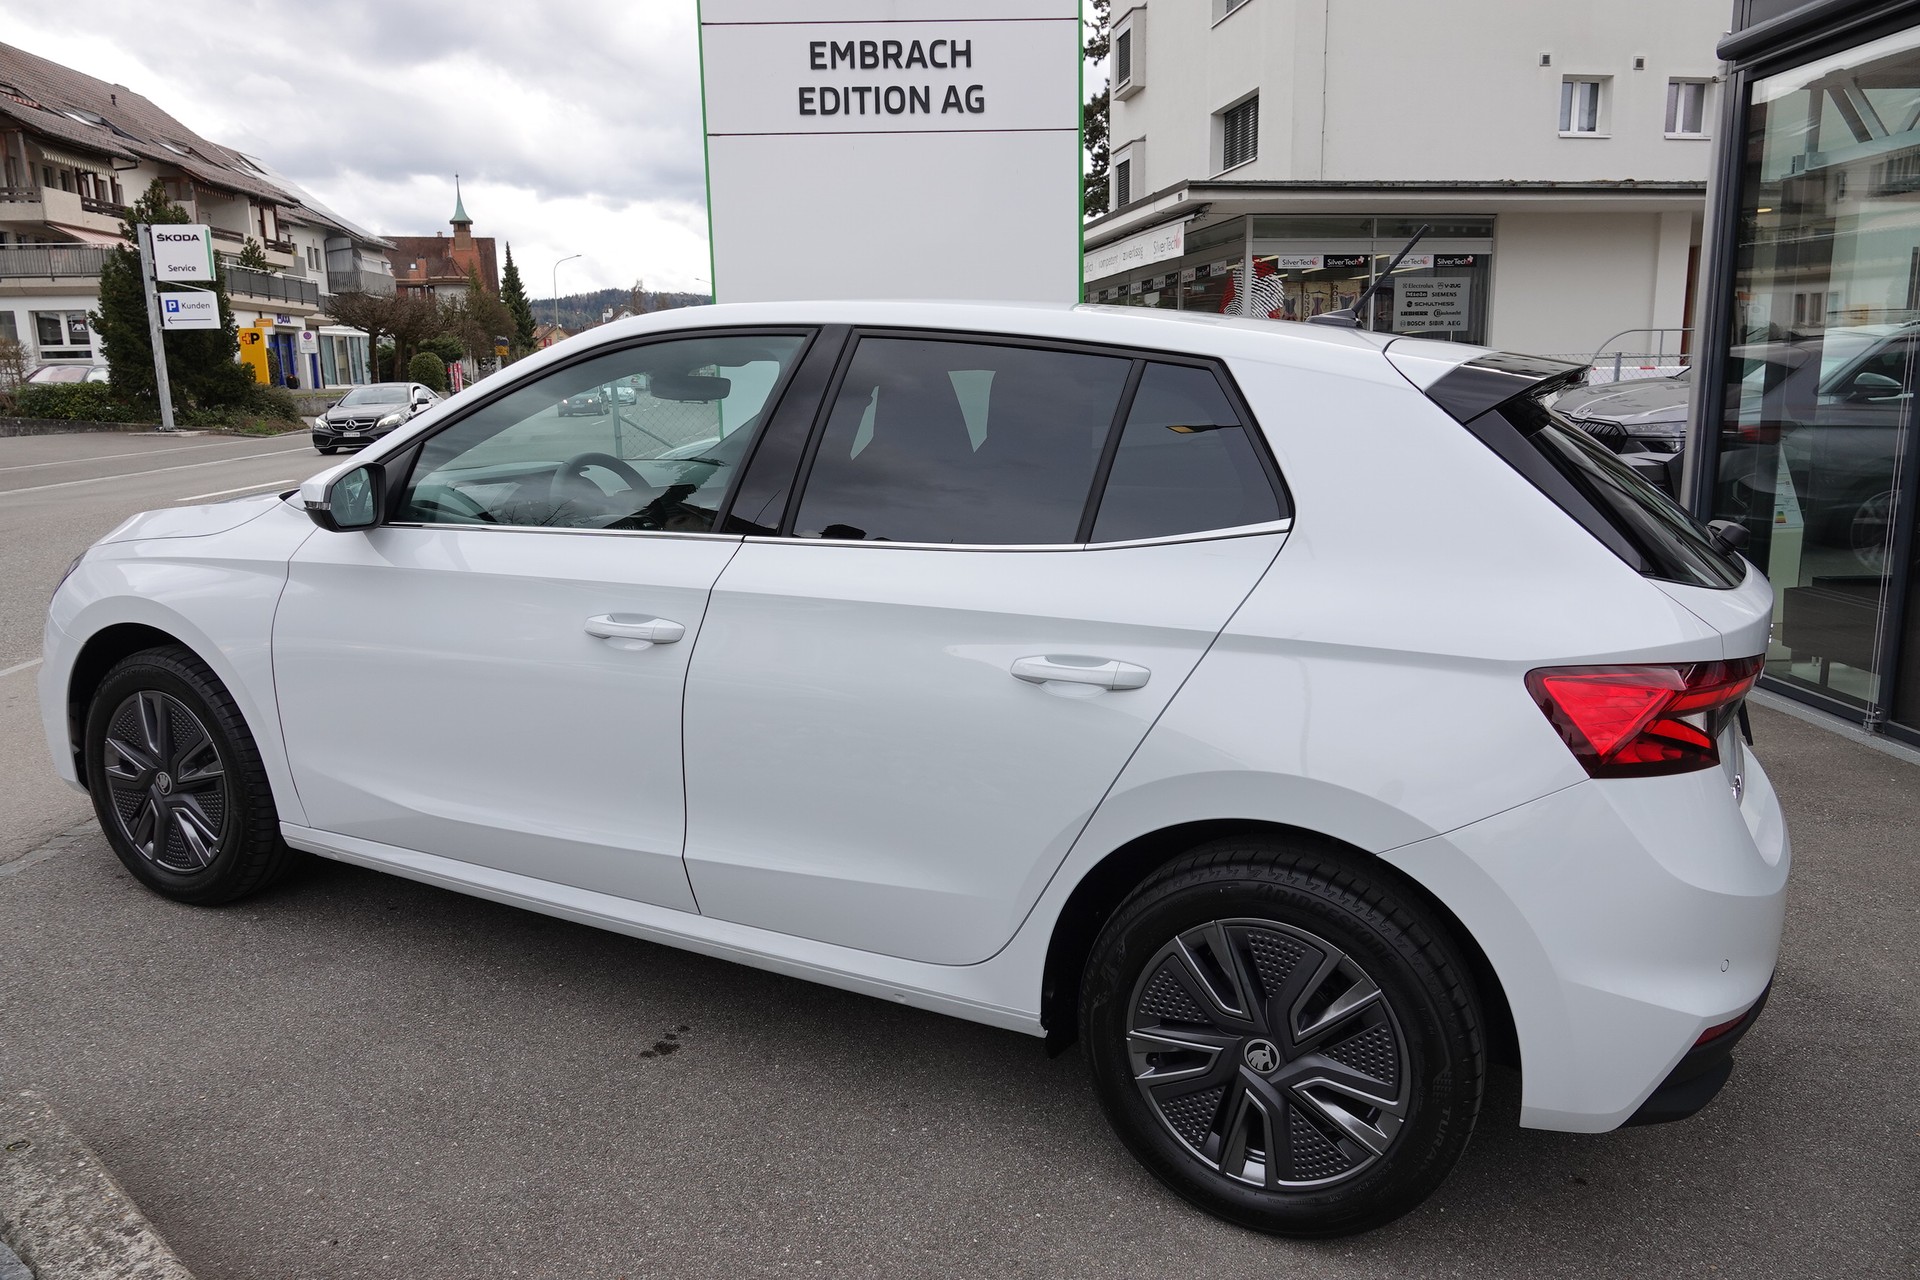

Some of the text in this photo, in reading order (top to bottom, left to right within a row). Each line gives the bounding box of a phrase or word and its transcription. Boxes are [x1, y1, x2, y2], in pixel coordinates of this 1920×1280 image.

[809, 39, 972, 70] EMBRACH
[798, 84, 985, 115] EDITION AG
[156, 232, 200, 242] ŠKODA
[167, 264, 197, 272] Service
[168, 301, 211, 311] P Kunden
